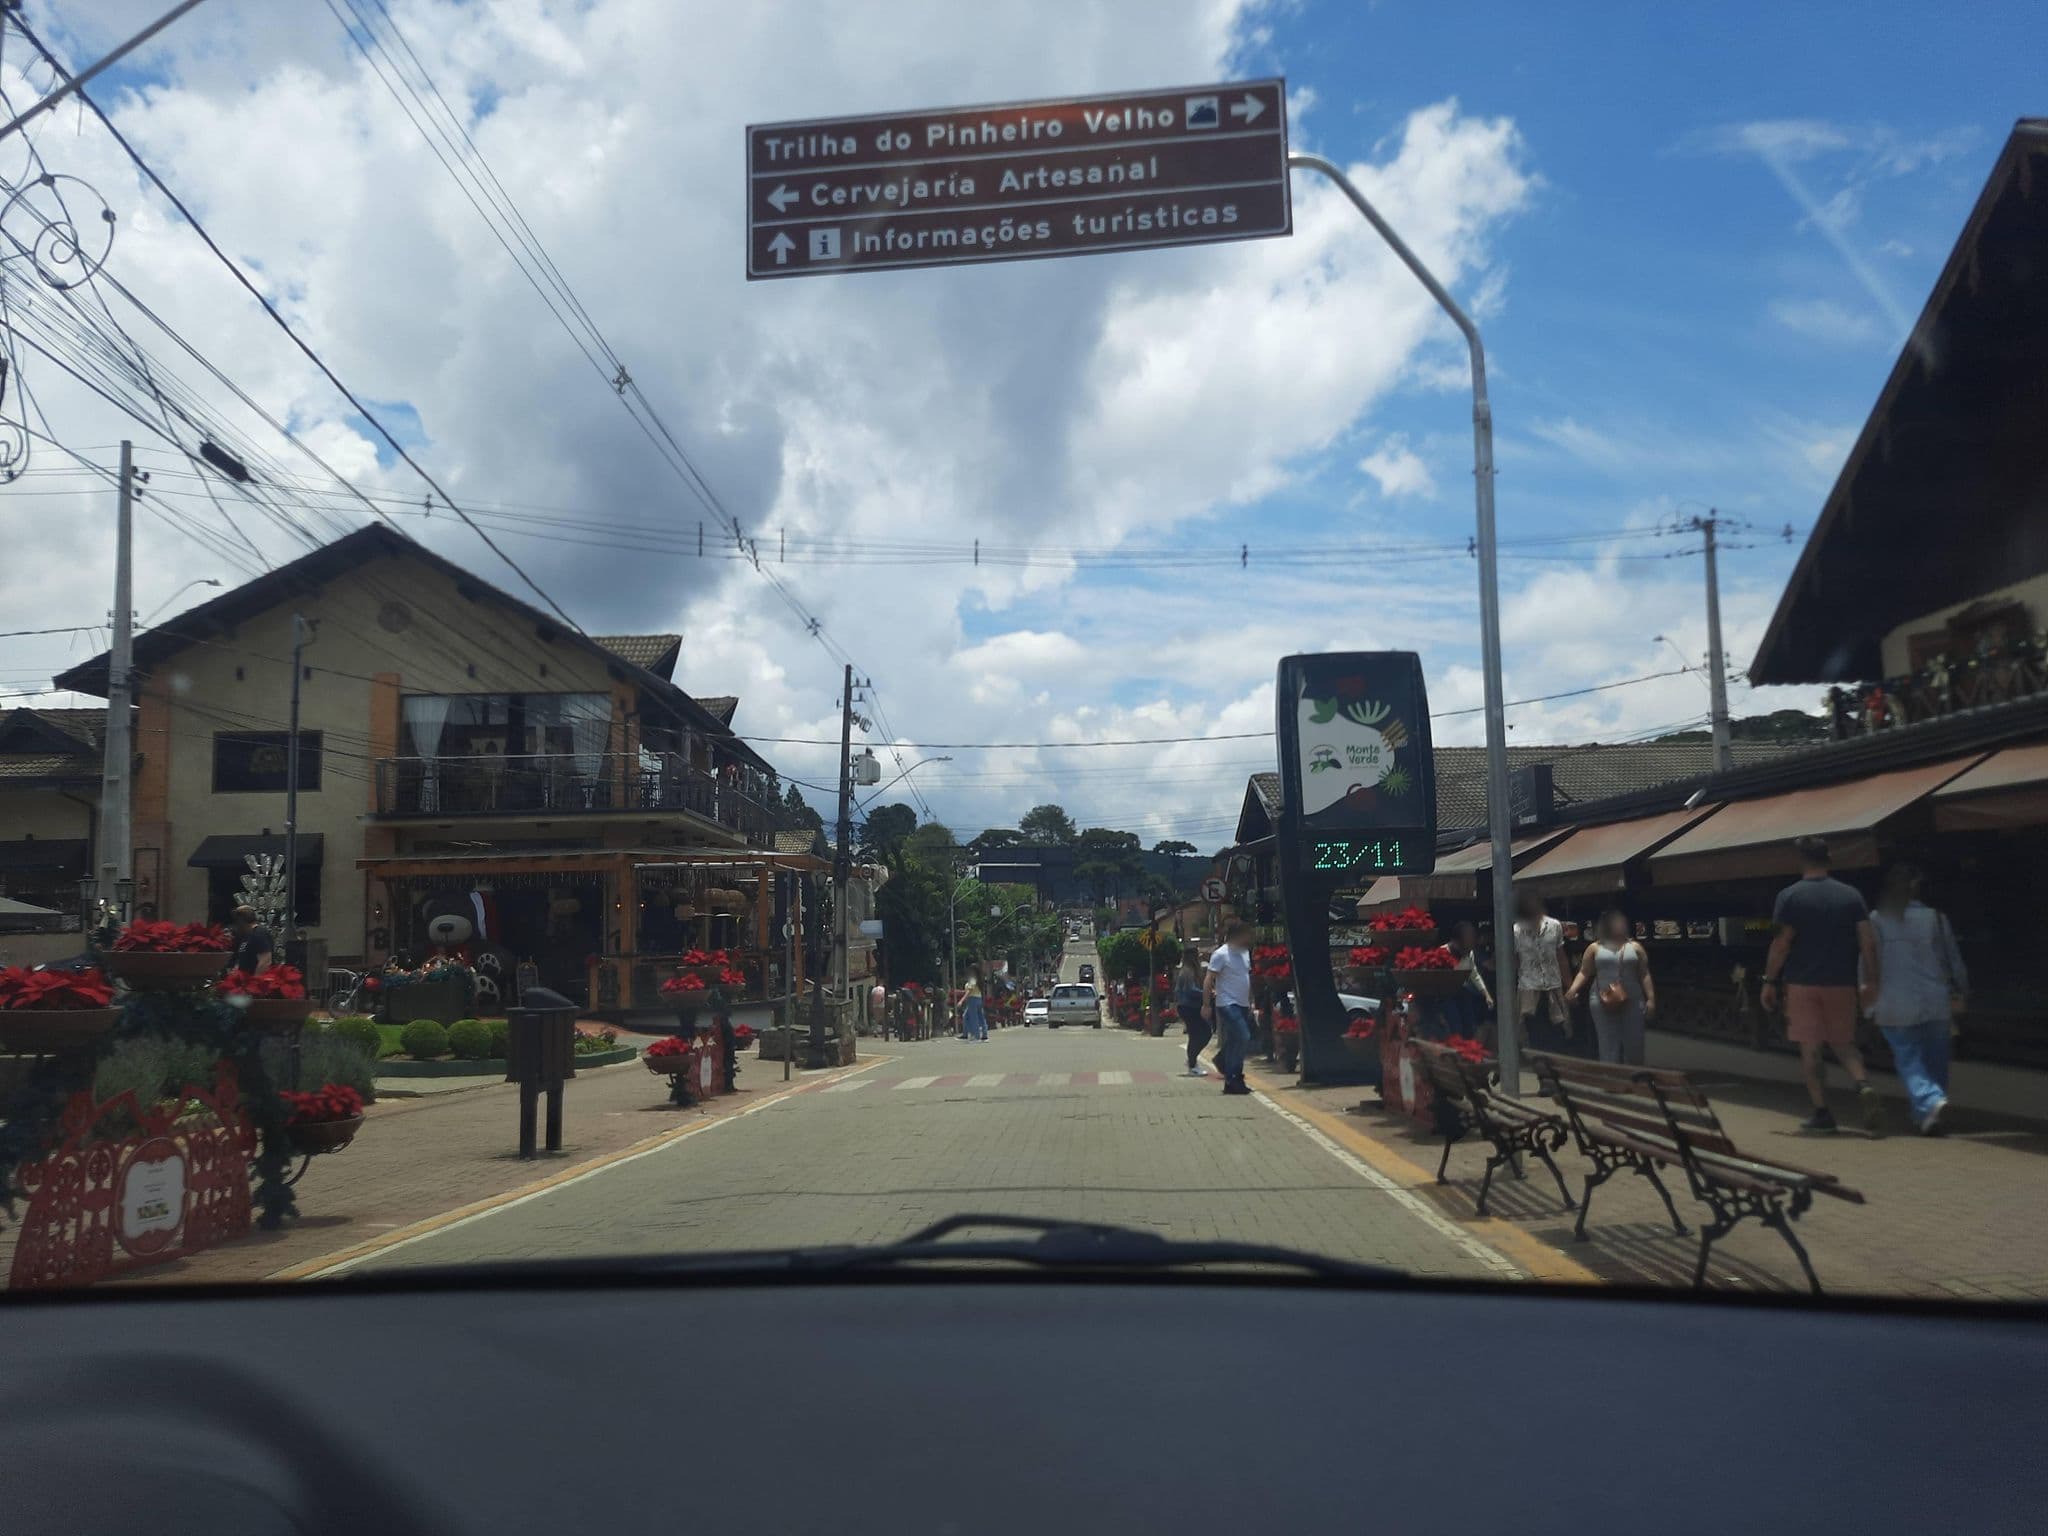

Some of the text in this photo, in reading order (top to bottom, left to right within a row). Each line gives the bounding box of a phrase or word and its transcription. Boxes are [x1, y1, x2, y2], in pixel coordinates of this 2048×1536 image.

[765, 107, 1175, 161] Trilha do Pinheiro Velho
[811, 155, 1157, 207] Cervejaria Artesanal
[854, 218, 1050, 253] Informações
[1072, 204, 1238, 235] turísticas
[1346, 745, 1380, 755] Monte
[1349, 755, 1379, 764] Verde
[1314, 841, 1404, 869] 23/11
